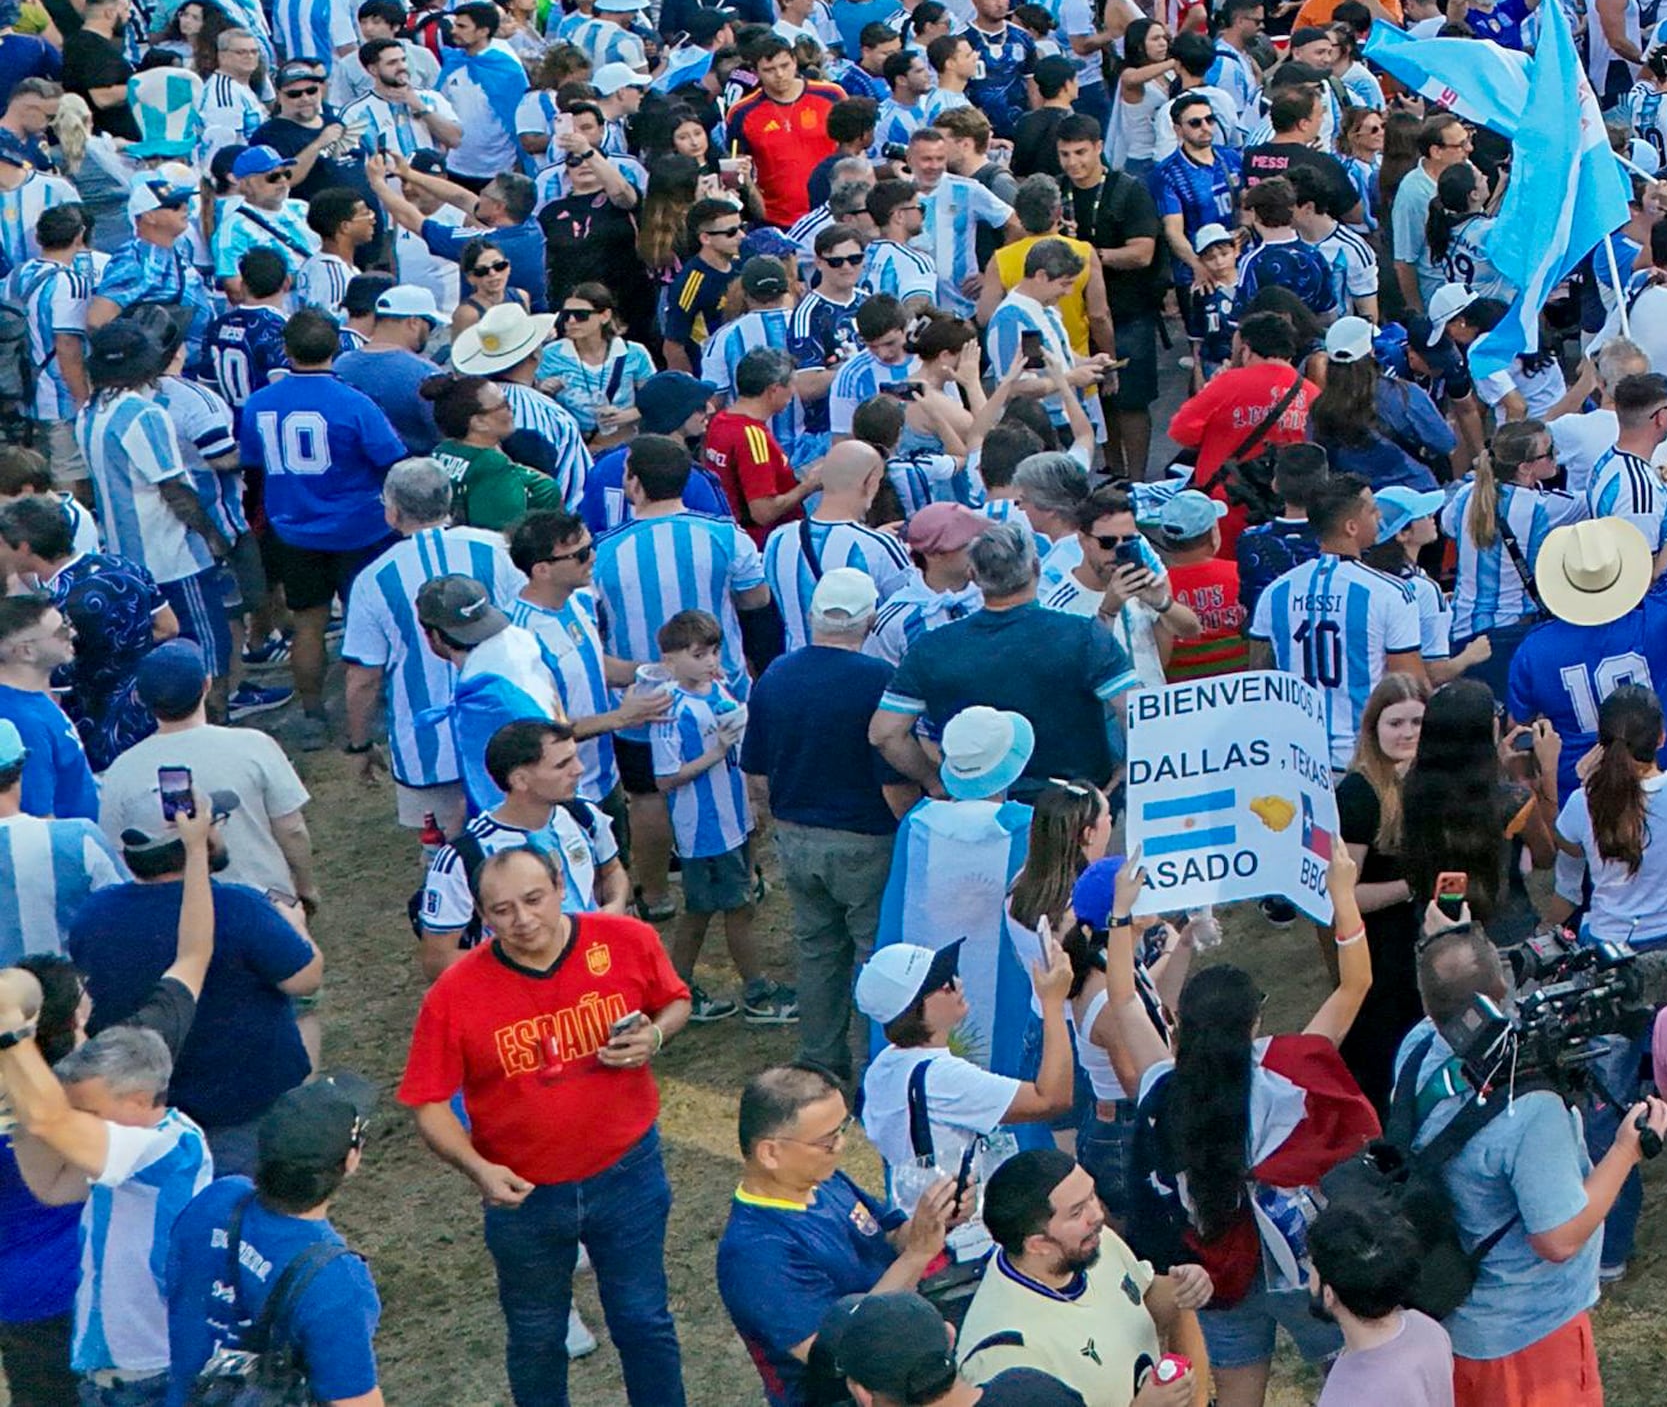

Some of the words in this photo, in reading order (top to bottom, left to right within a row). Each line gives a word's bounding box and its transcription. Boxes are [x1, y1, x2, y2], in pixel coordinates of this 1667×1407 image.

[1251, 155, 1289, 170] MESSI
[1213, 192, 1233, 217] 10
[211, 344, 251, 408] 10
[256, 411, 332, 475] 10
[1293, 595, 1343, 613] MESSI
[1293, 619, 1342, 688] 10
[1128, 677, 1314, 728] ¡BIENVENIDOS
[1316, 699, 1326, 725] A
[1560, 650, 1654, 733] 10
[1129, 739, 1271, 785] DALLAS
[1134, 851, 1259, 890] ASADO
[496, 992, 630, 1078] ESPAÑA
